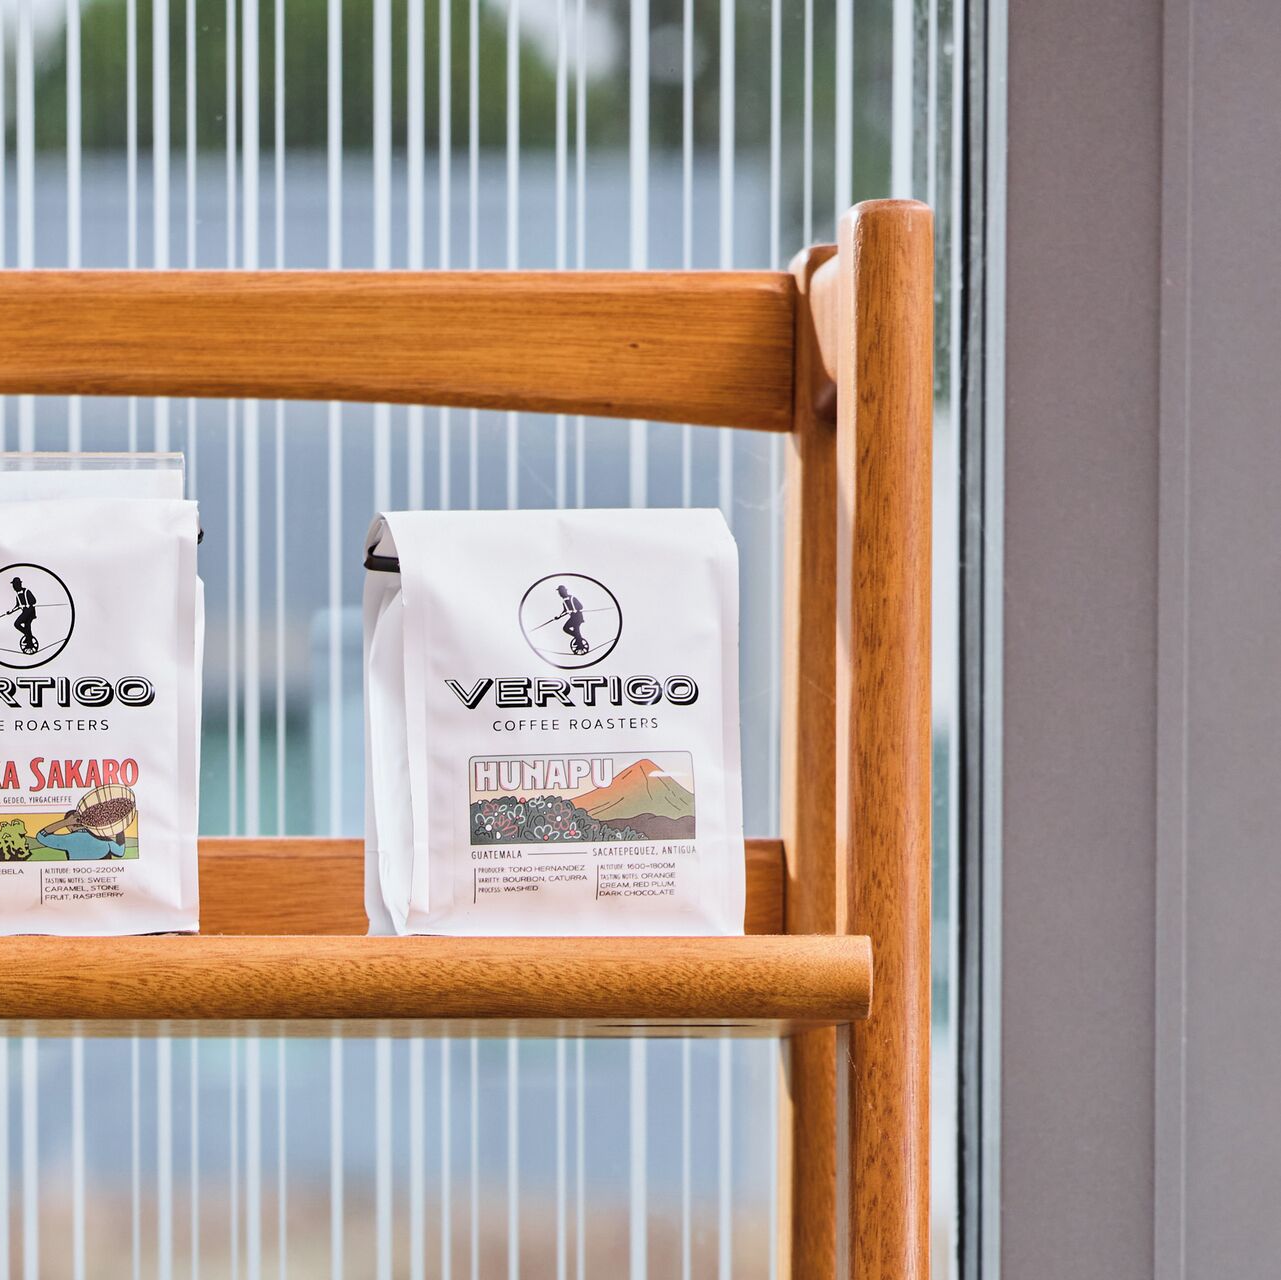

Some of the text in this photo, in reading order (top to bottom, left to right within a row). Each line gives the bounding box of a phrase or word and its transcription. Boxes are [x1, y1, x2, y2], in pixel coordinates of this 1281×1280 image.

[444, 675, 699, 709] VERTIGO
[15, 719, 109, 731] ROASTERS
[493, 718, 658, 732] COFFEE ROASTERS
[29, 757, 139, 792] SAKARO
[475, 758, 613, 791] HUNAPU
[471, 850, 522, 860] GUATEMALA
[593, 846, 696, 856] SACATEPEQUEZ, ANTIGUA
